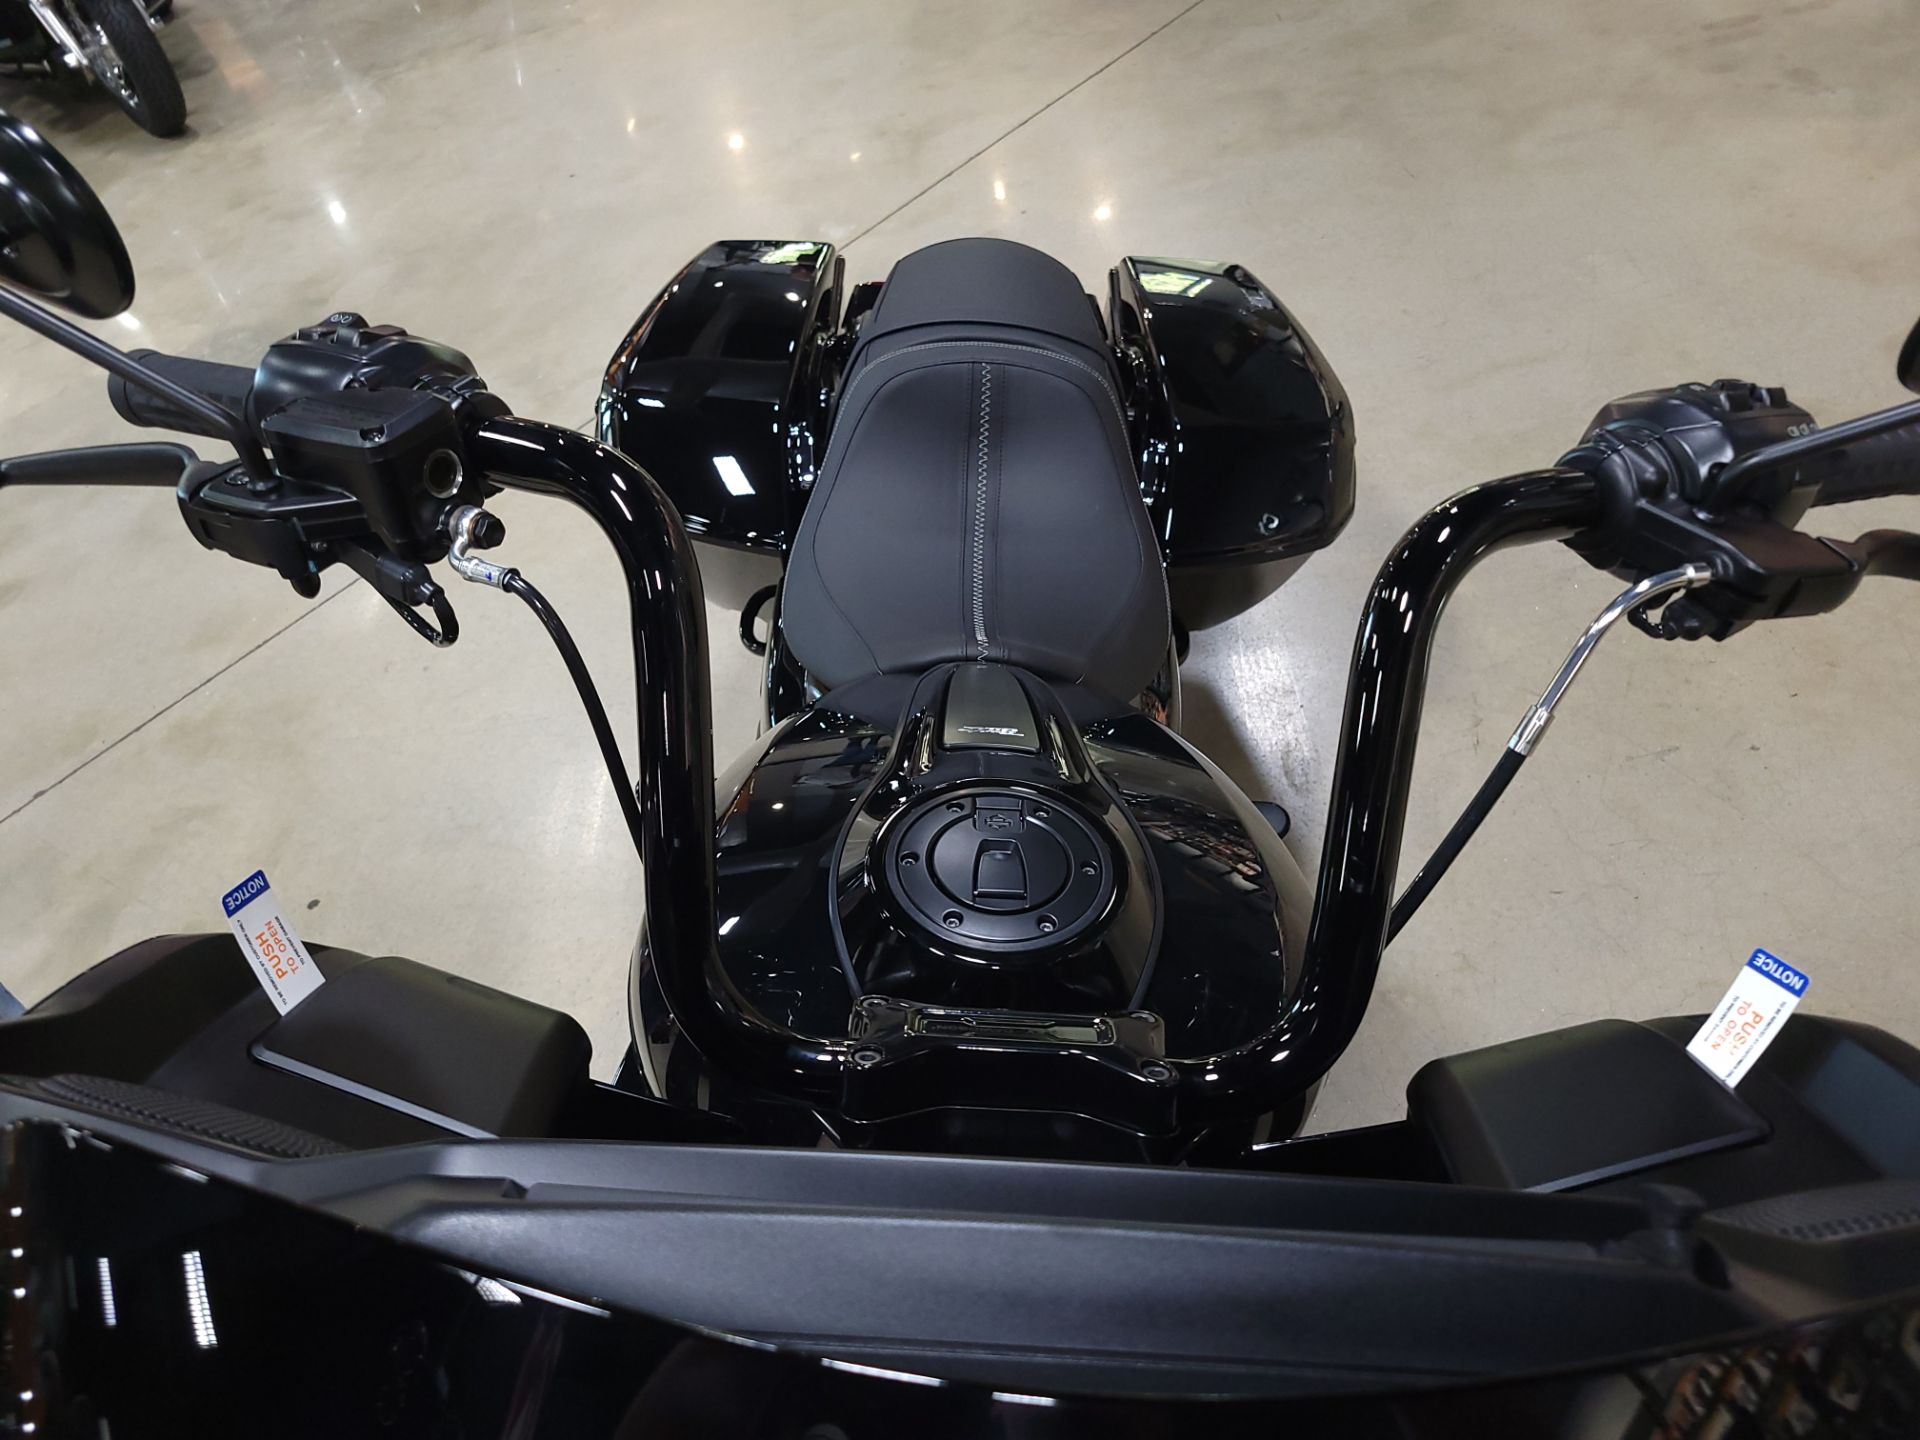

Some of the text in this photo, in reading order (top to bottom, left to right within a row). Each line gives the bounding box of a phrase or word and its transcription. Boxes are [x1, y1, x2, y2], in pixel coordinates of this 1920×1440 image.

[225, 875, 265, 909] NOTICE
[255, 931, 288, 979] PUSH
[264, 920, 300, 974] TO OPEN
[1752, 952, 1805, 990] NOTICE
[1735, 1000, 1752, 1016] TO
[1710, 1019, 1738, 1050] OPEN
